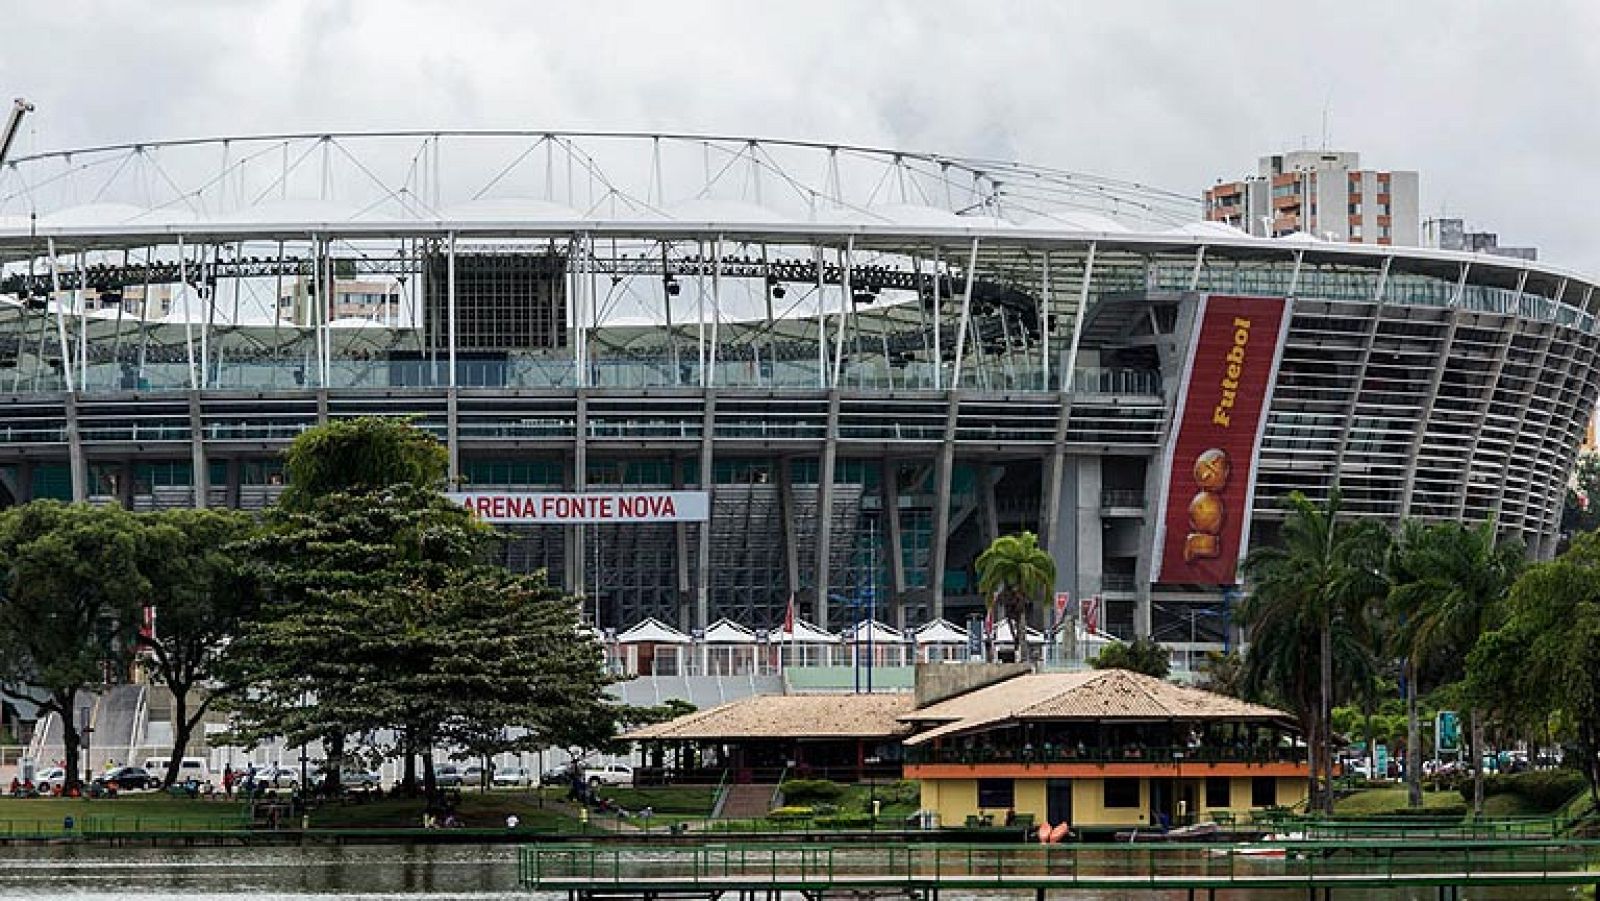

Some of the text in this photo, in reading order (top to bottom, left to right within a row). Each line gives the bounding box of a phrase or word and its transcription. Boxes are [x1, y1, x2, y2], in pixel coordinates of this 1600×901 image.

[1213, 317, 1251, 427] Futebol
[541, 496, 613, 518] FONTE
[618, 495, 676, 518] NOVA
